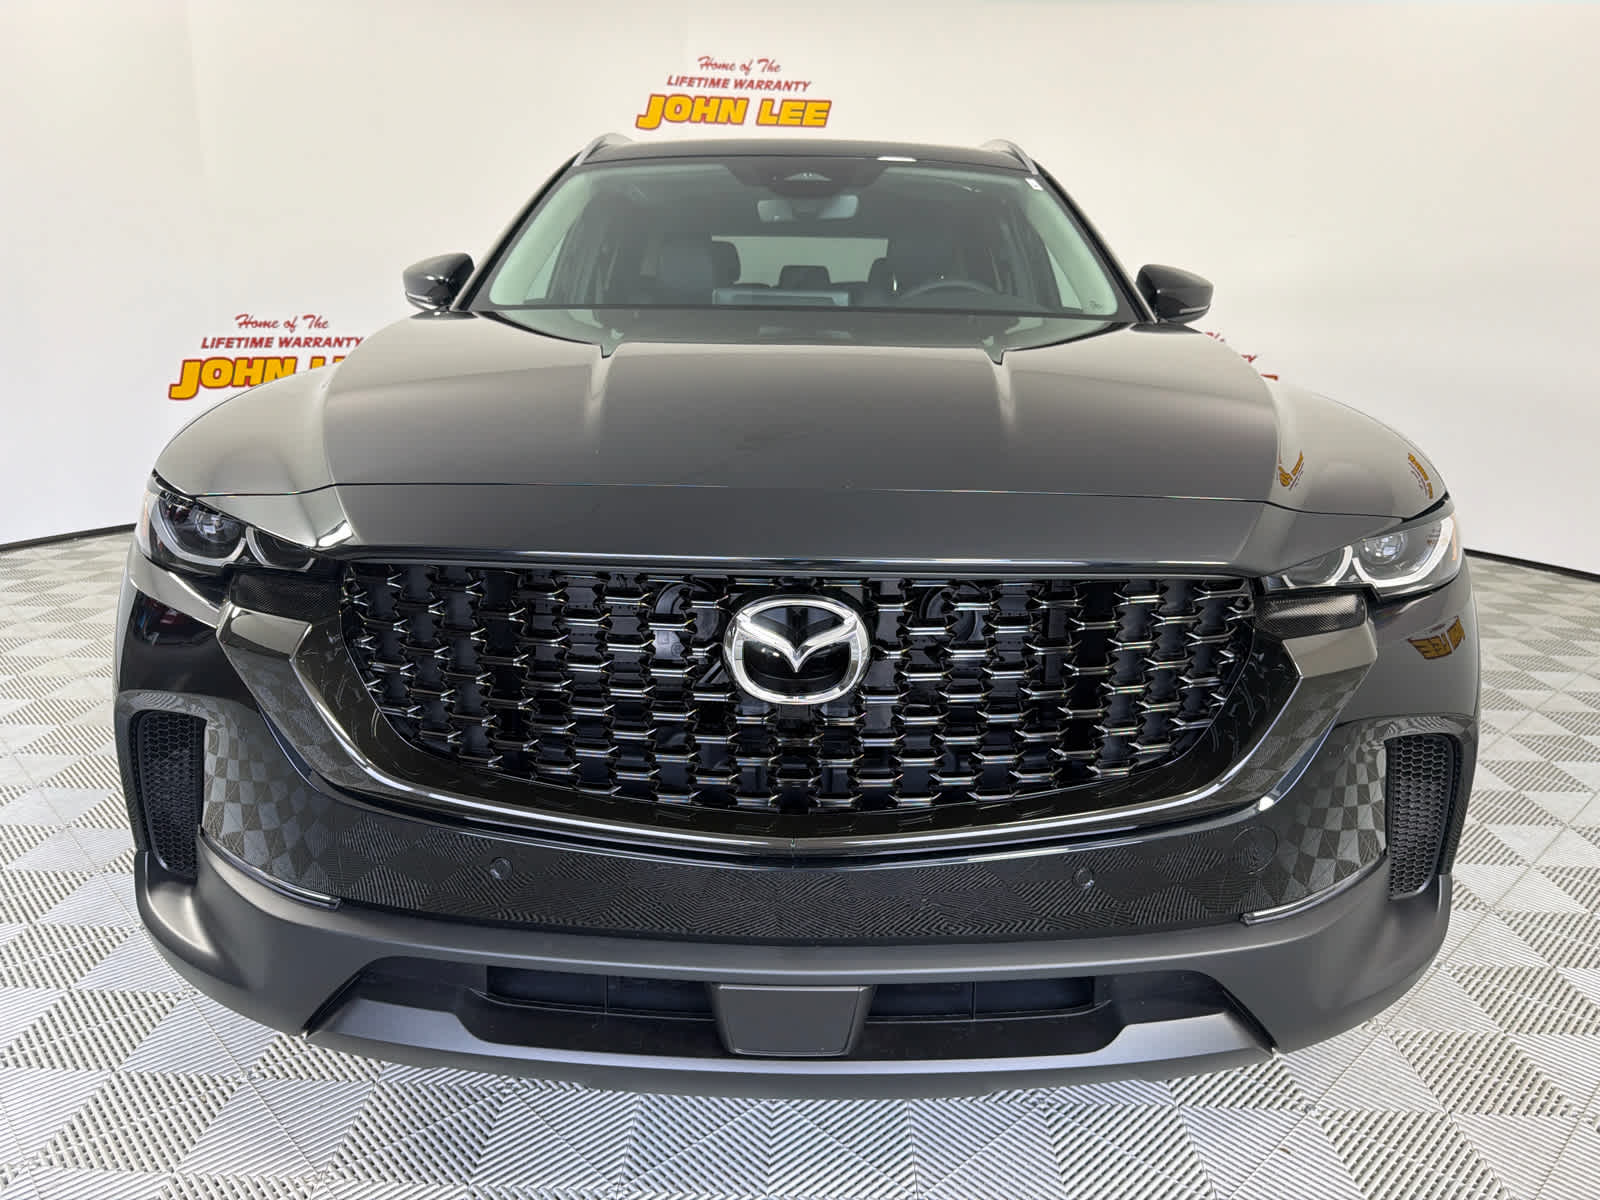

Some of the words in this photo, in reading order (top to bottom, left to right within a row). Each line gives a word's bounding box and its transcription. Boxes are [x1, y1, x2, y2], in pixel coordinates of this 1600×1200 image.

[698, 55, 736, 73] Home
[739, 59, 753, 76] of
[757, 58, 781, 73] The
[666, 75, 730, 90] LIFETIME
[733, 78, 812, 93] WARRANTY
[635, 93, 750, 131] JOHN
[756, 98, 832, 129] LEE
[235, 313, 280, 329] Home
[283, 315, 298, 333] of
[302, 314, 329, 329] The
[201, 336, 274, 350] LIFETIME
[278, 336, 364, 349] WARRANTY
[168, 355, 298, 401] JOHN
